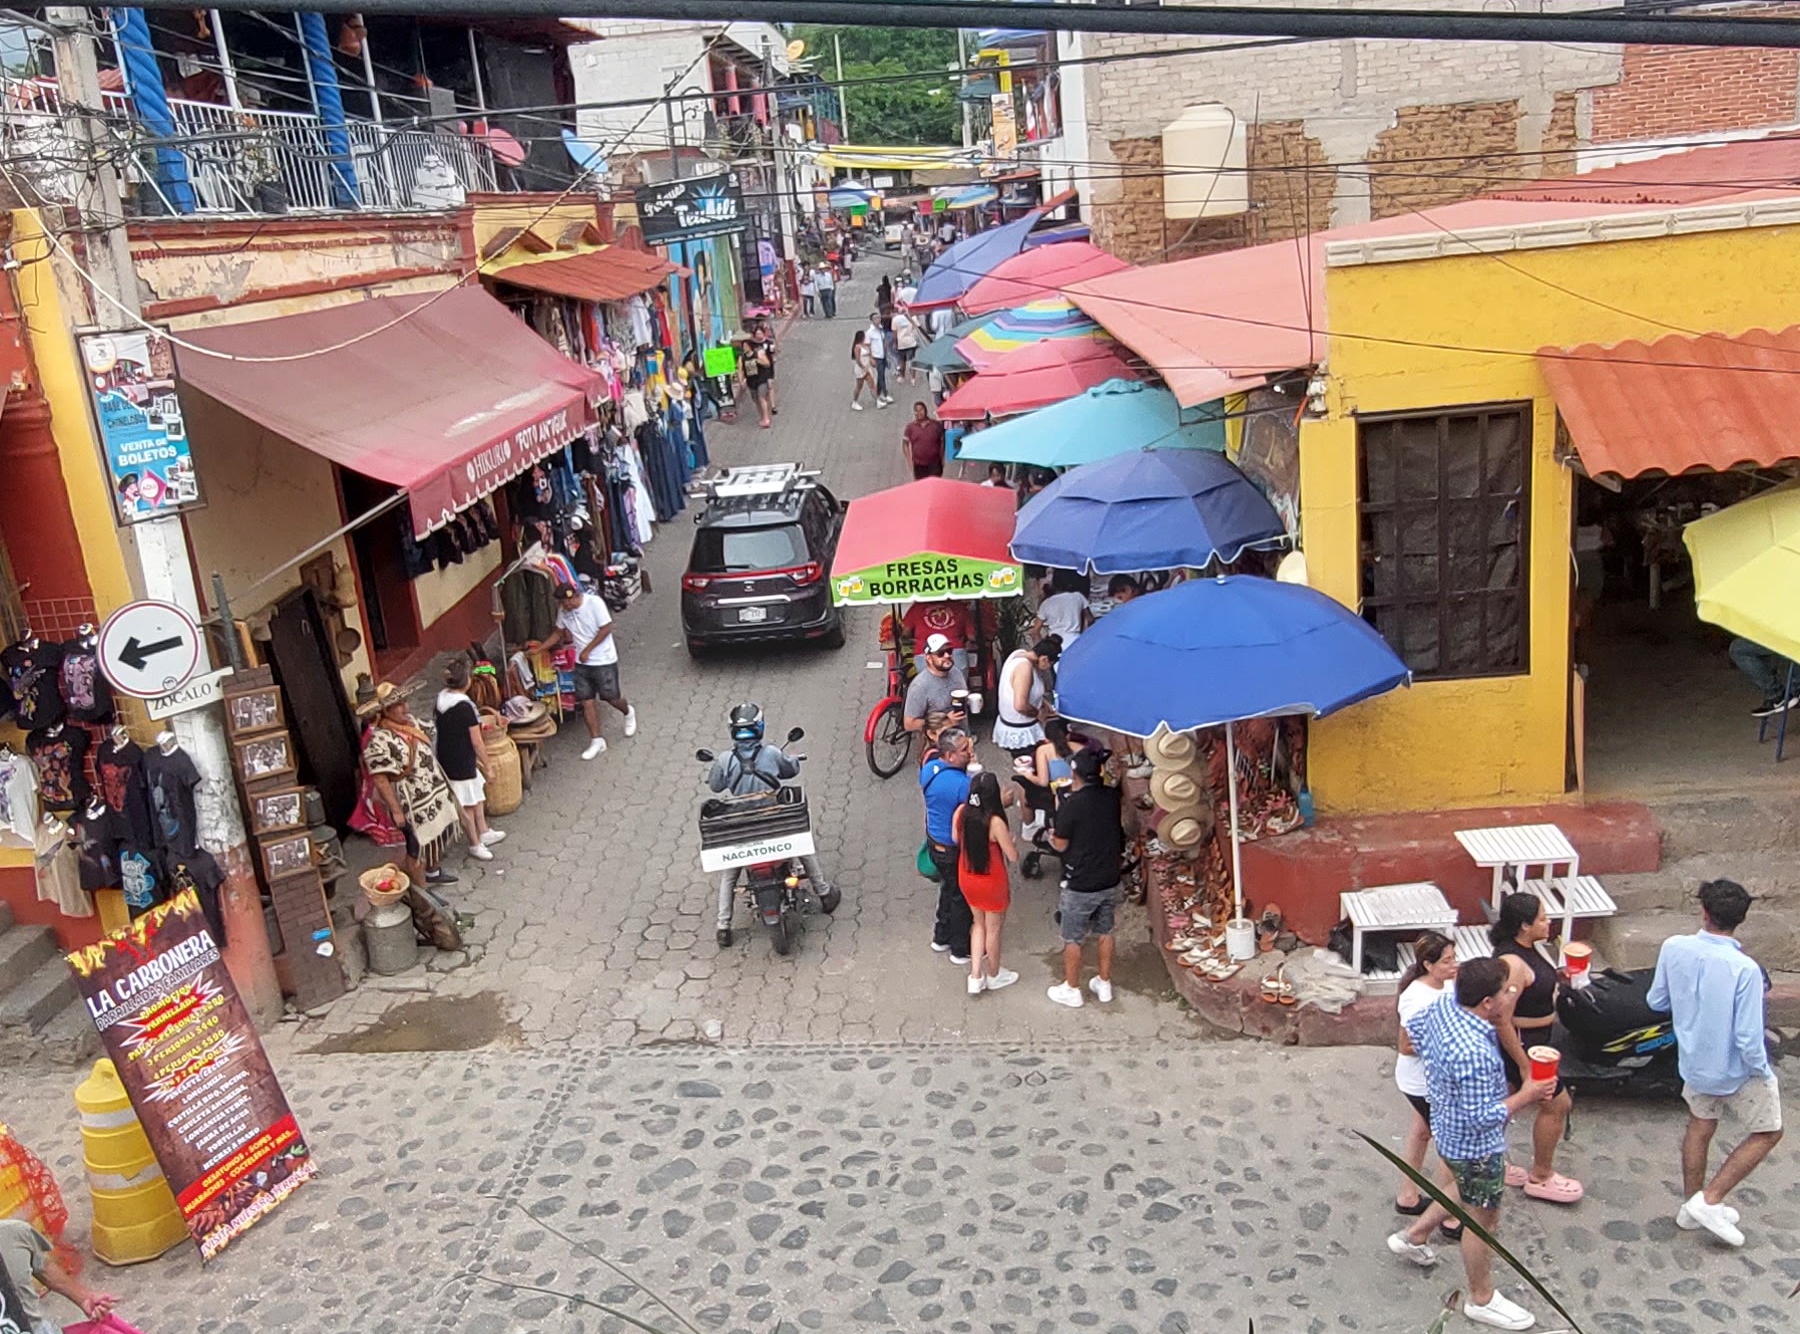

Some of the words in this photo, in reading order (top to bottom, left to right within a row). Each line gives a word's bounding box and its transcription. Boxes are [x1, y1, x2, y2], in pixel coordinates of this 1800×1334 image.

[118, 445, 177, 466] BOLETOS
[120, 439, 155, 452] VENTA
[869, 572, 984, 597] BORRACHAS
[887, 559, 958, 578] FRESAS
[86, 987, 115, 1018] LA
[113, 927, 215, 1001] CARBONERA
[94, 981, 163, 1031] PARRILLADAS
[161, 946, 220, 990] FAMILIARES
[144, 993, 197, 1031] PARRILLADA
[152, 1029, 195, 1063] PERSONAS
[153, 1072, 159, 1080] 4
[159, 1043, 201, 1076] PERSONAS
[167, 1100, 202, 1127] COSTILLA
[177, 1107, 211, 1134] CHULETA
[183, 1110, 226, 1143] LONGANIZA
[195, 1128, 219, 1149] JARRA
[218, 1120, 230, 1132] DE
[229, 1107, 249, 1125] AGUA
[202, 1145, 232, 1170] HECHAS
[231, 1141, 237, 1149] A
[236, 1125, 260, 1145] MANO
[206, 1122, 246, 1153] TORTILLAS
[201, 1153, 244, 1187] DESAYUNOS
[183, 1179, 224, 1212] HUARACHES
[230, 1190, 275, 1228] NUESTRA
